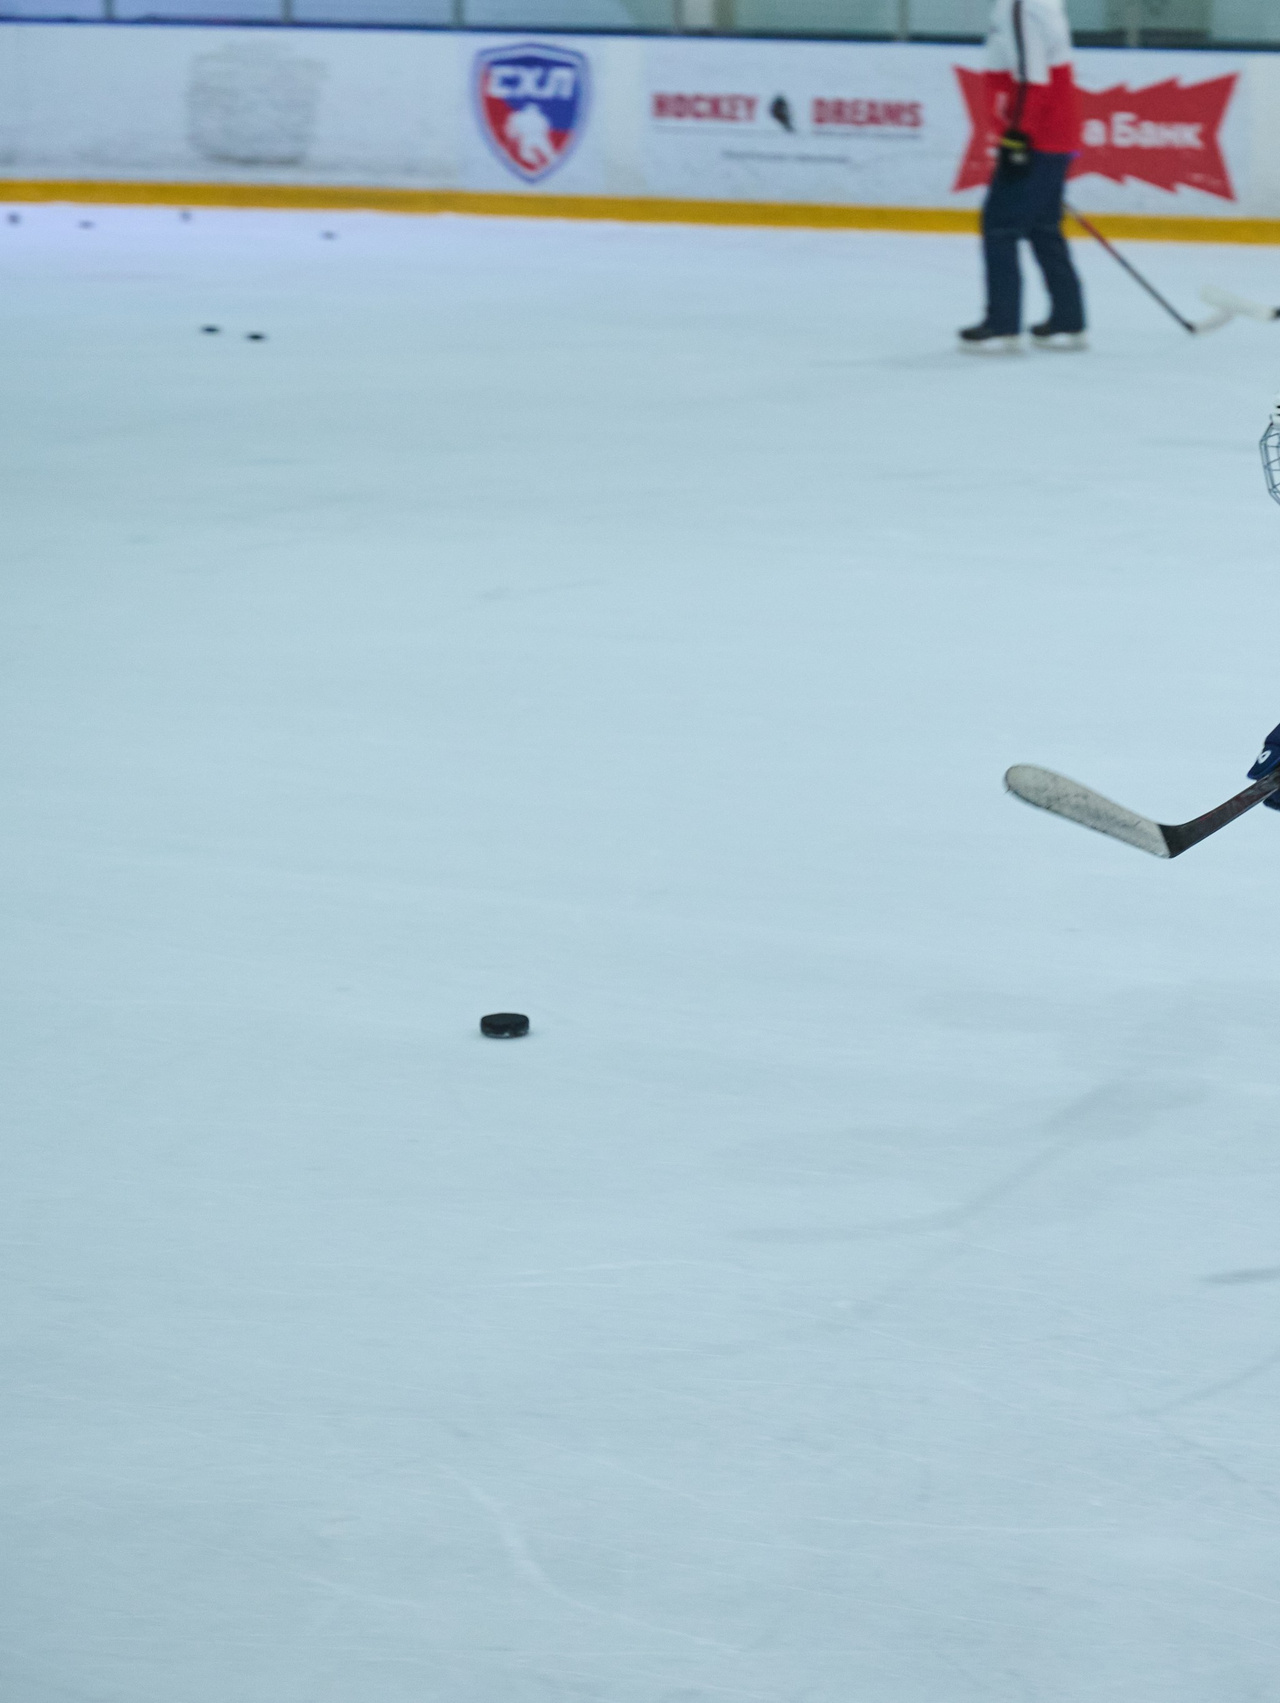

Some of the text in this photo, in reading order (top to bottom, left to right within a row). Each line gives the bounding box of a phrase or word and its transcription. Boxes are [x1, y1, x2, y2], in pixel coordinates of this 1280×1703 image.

[652, 93, 923, 128] HOCKEY DREAMS
[1111, 111, 1204, 149] Банк
